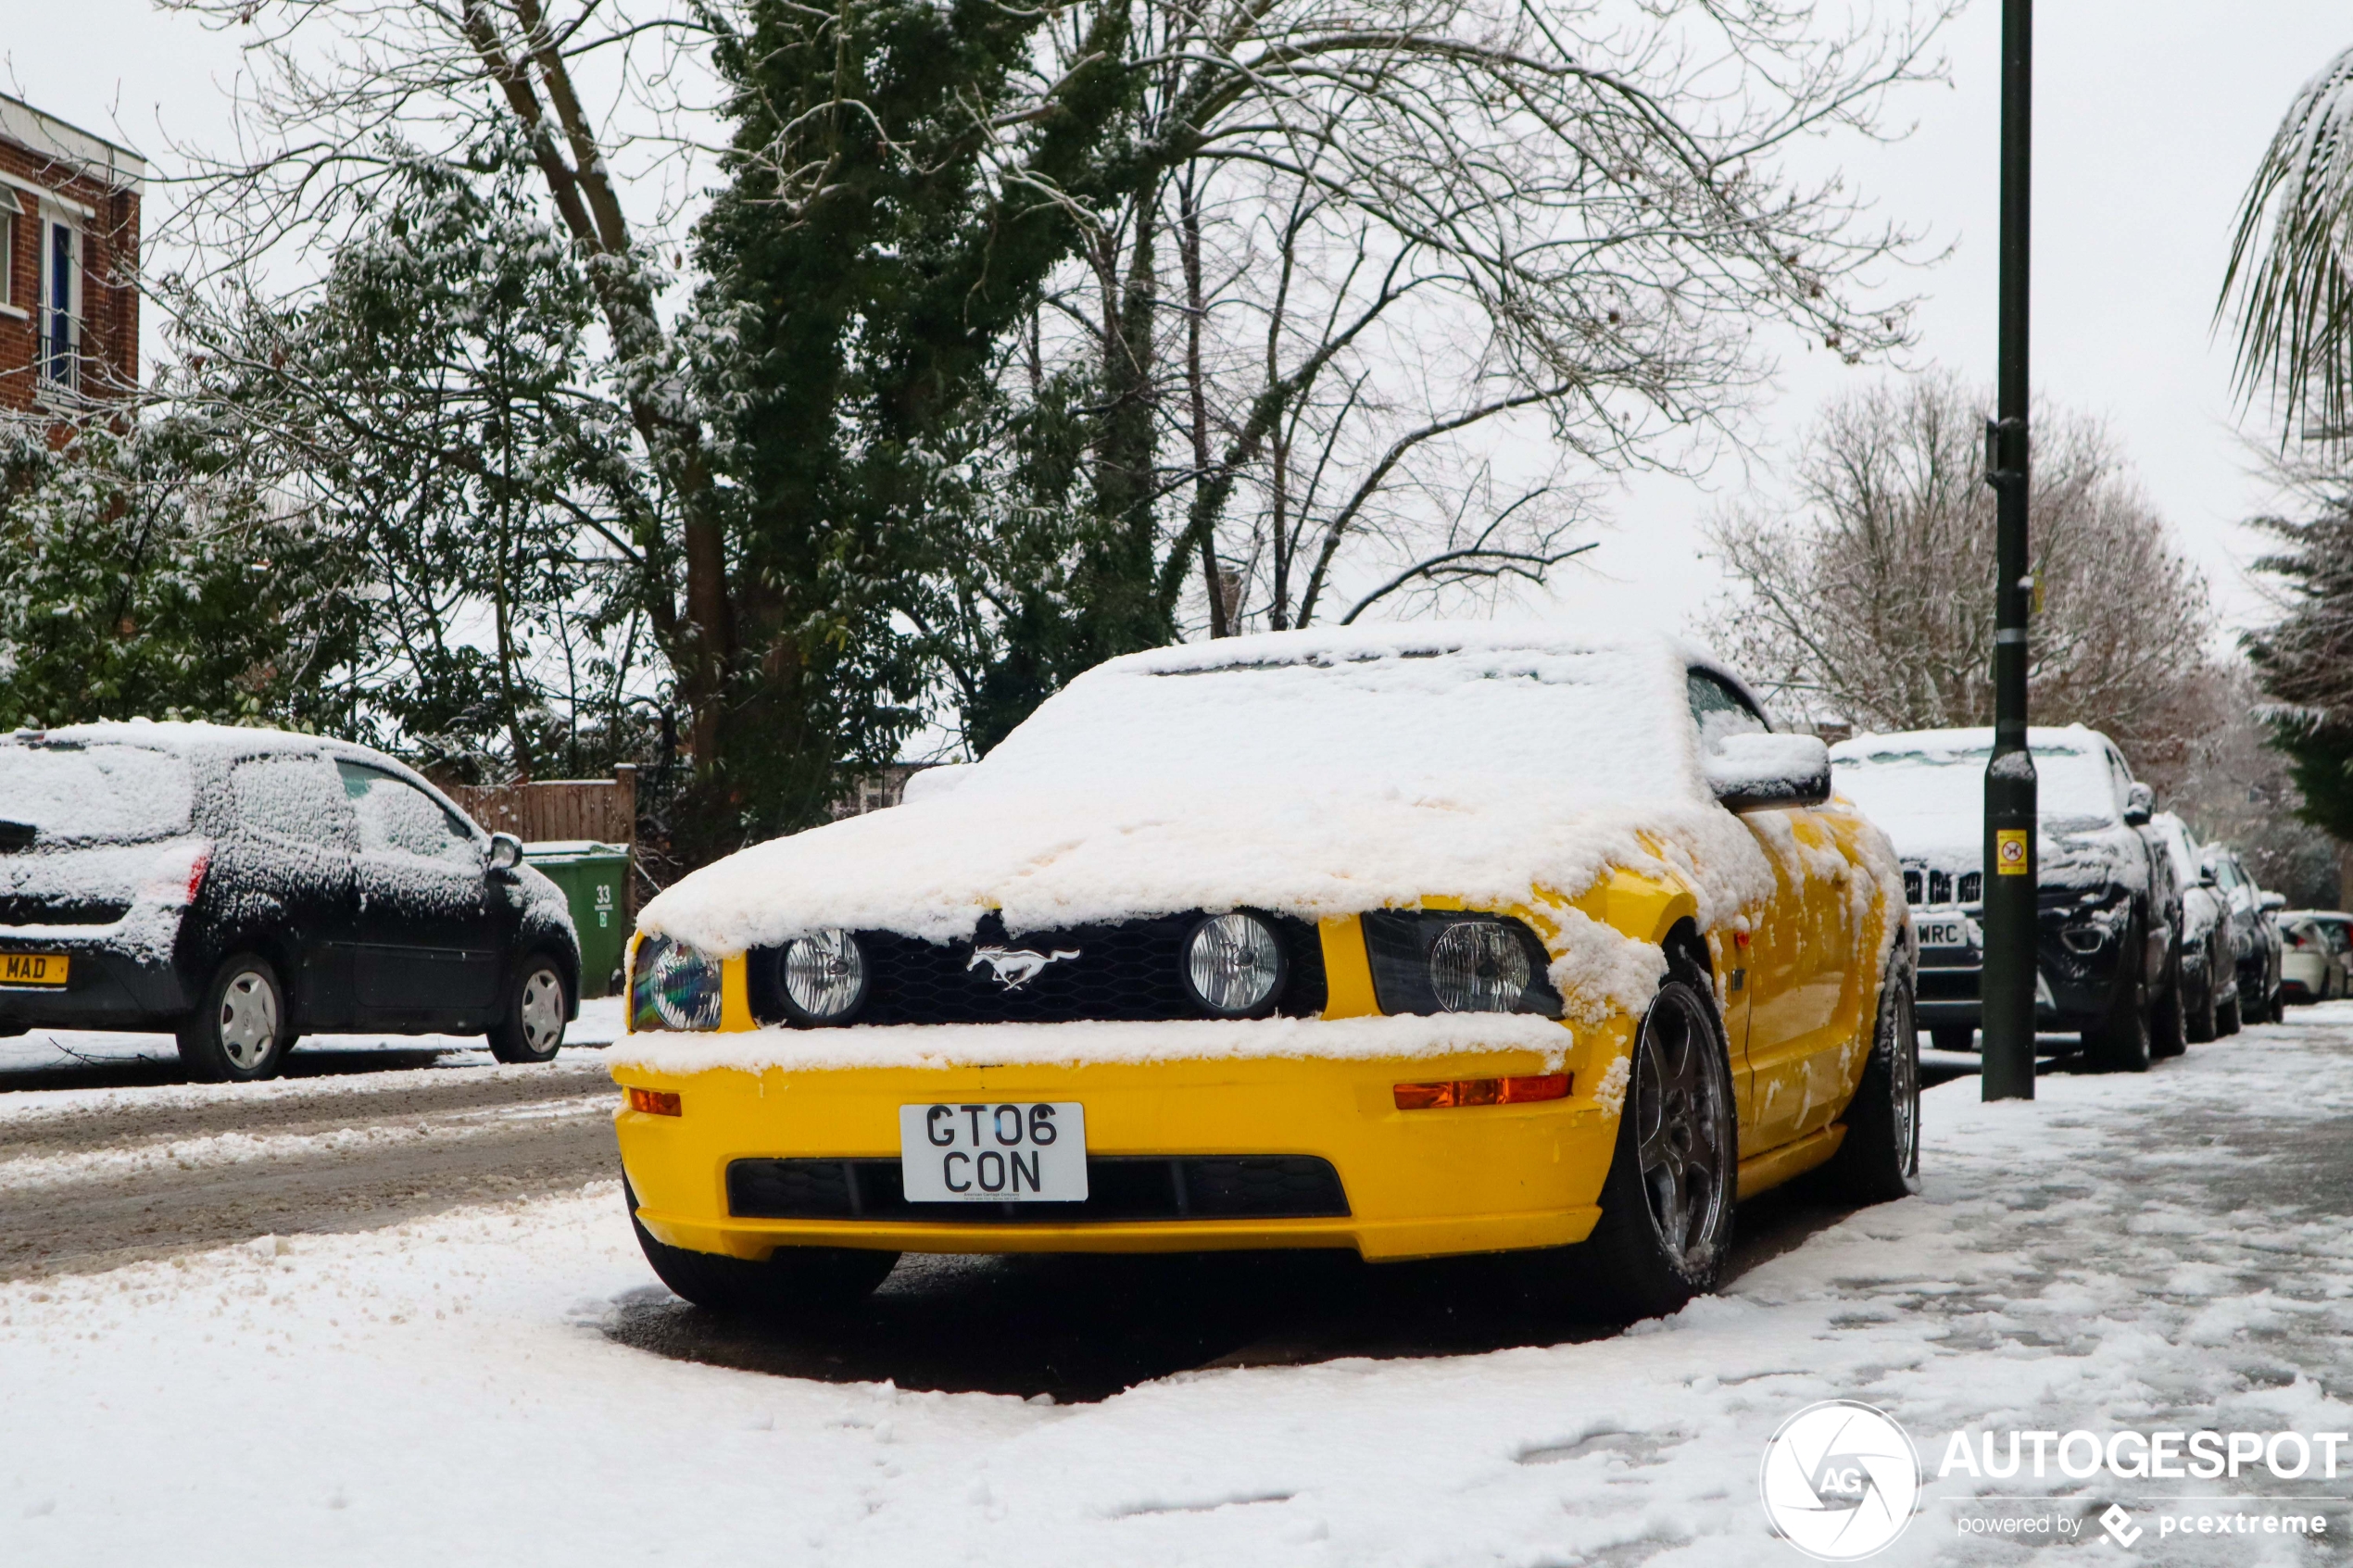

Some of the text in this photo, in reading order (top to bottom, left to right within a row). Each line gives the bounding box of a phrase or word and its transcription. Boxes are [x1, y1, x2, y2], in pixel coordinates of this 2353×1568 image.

[597, 884, 610, 904] 33
[1918, 924, 1957, 943] WRC
[6, 957, 46, 978] MAD
[943, 1150, 1041, 1193] CON
